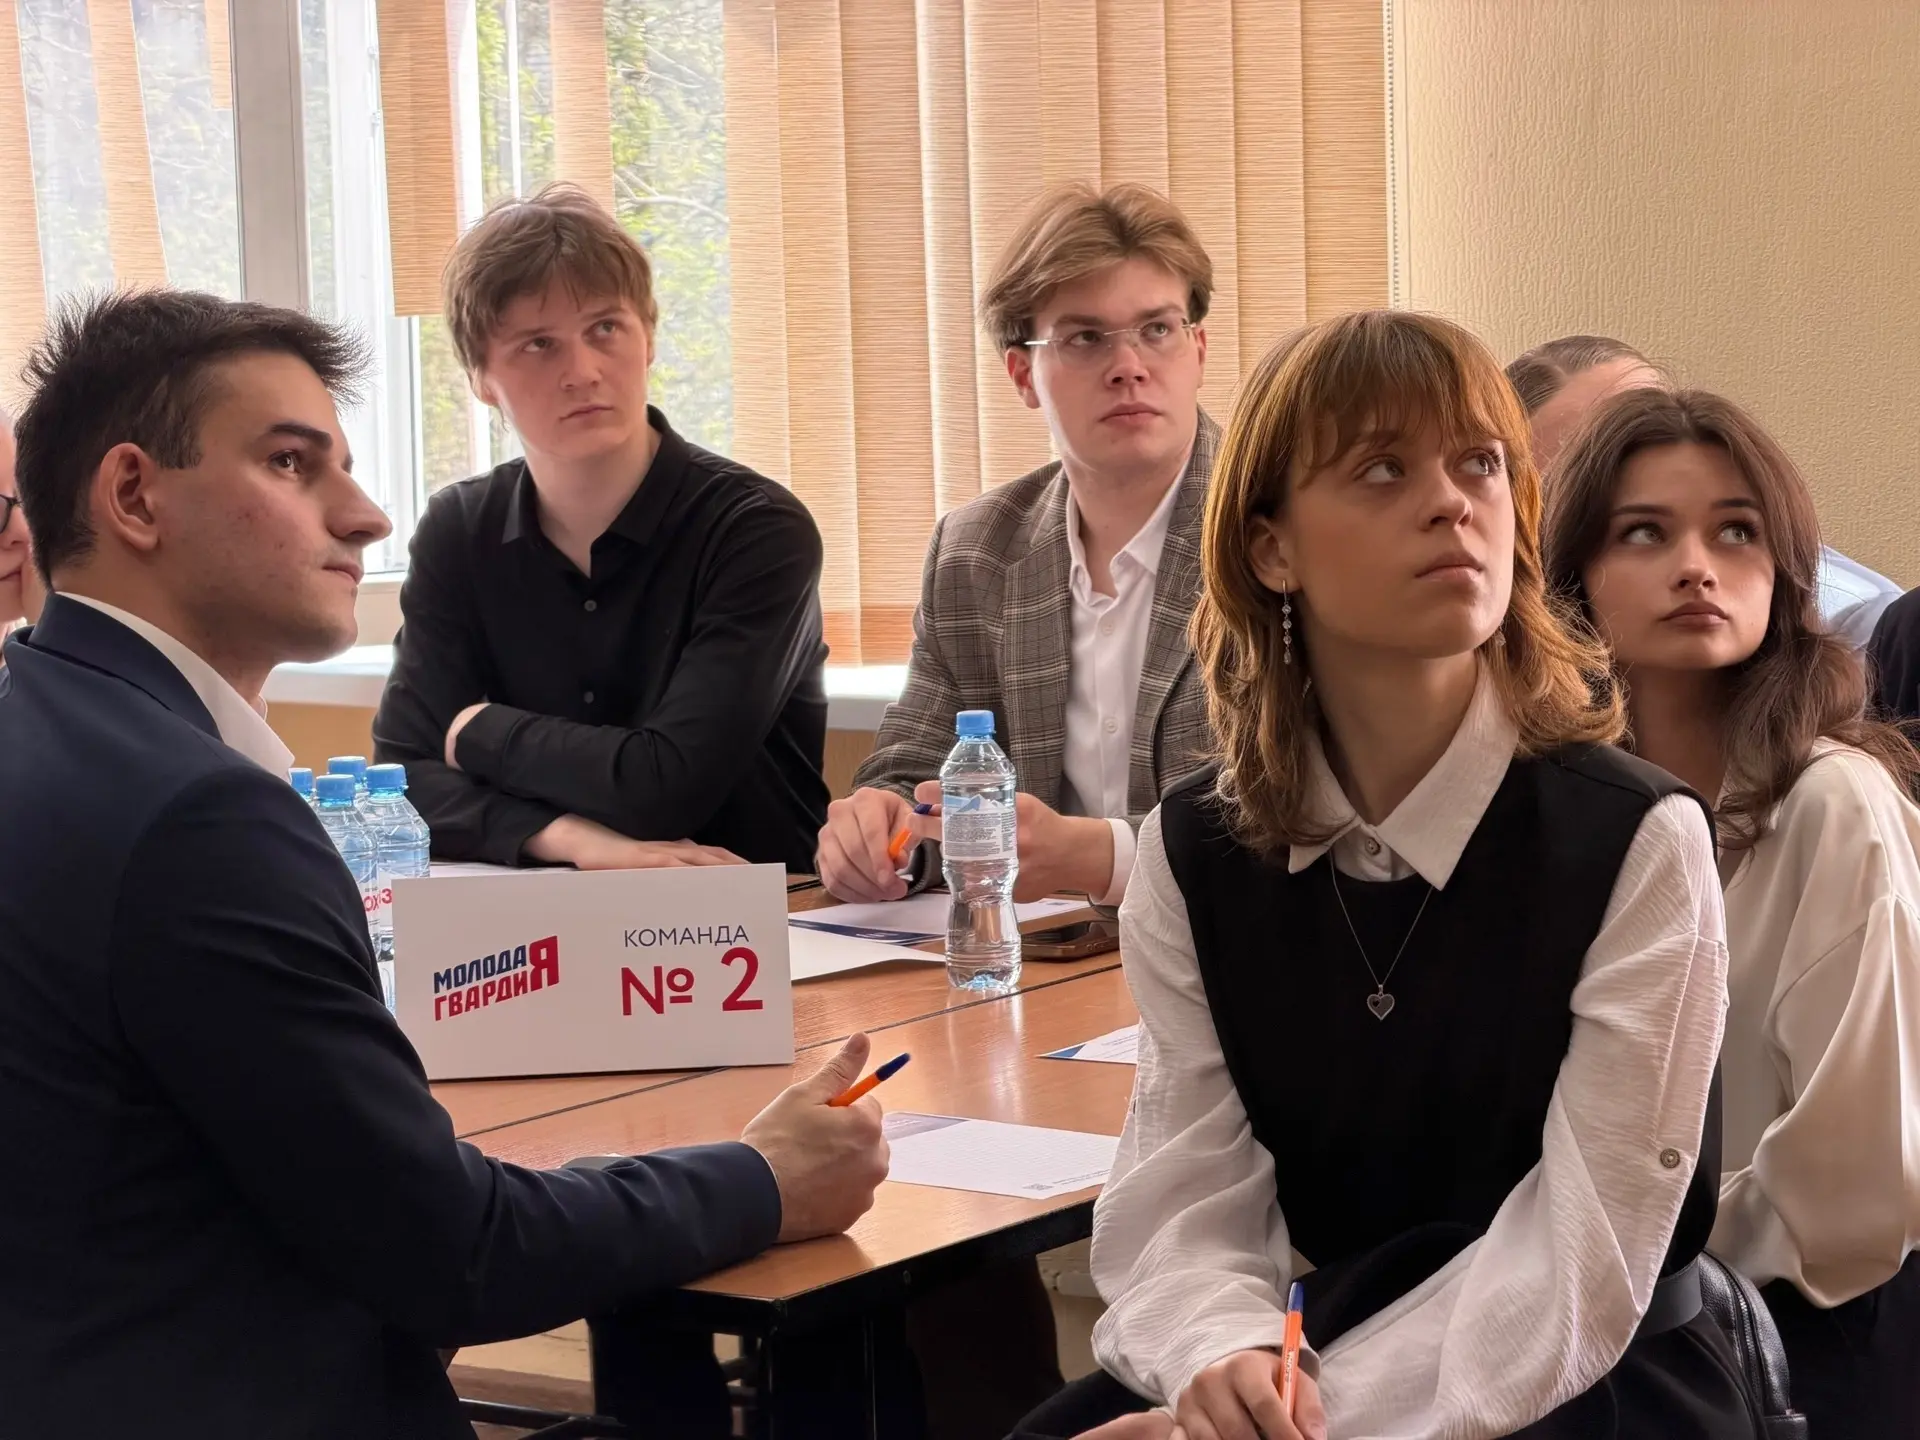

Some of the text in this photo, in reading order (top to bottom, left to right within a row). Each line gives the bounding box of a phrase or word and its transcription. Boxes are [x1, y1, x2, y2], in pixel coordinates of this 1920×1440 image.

[433, 935, 559, 994] МОЛОДАЯ
[624, 925, 750, 947] КОМАНДА
[621, 947, 764, 1016] № 2
